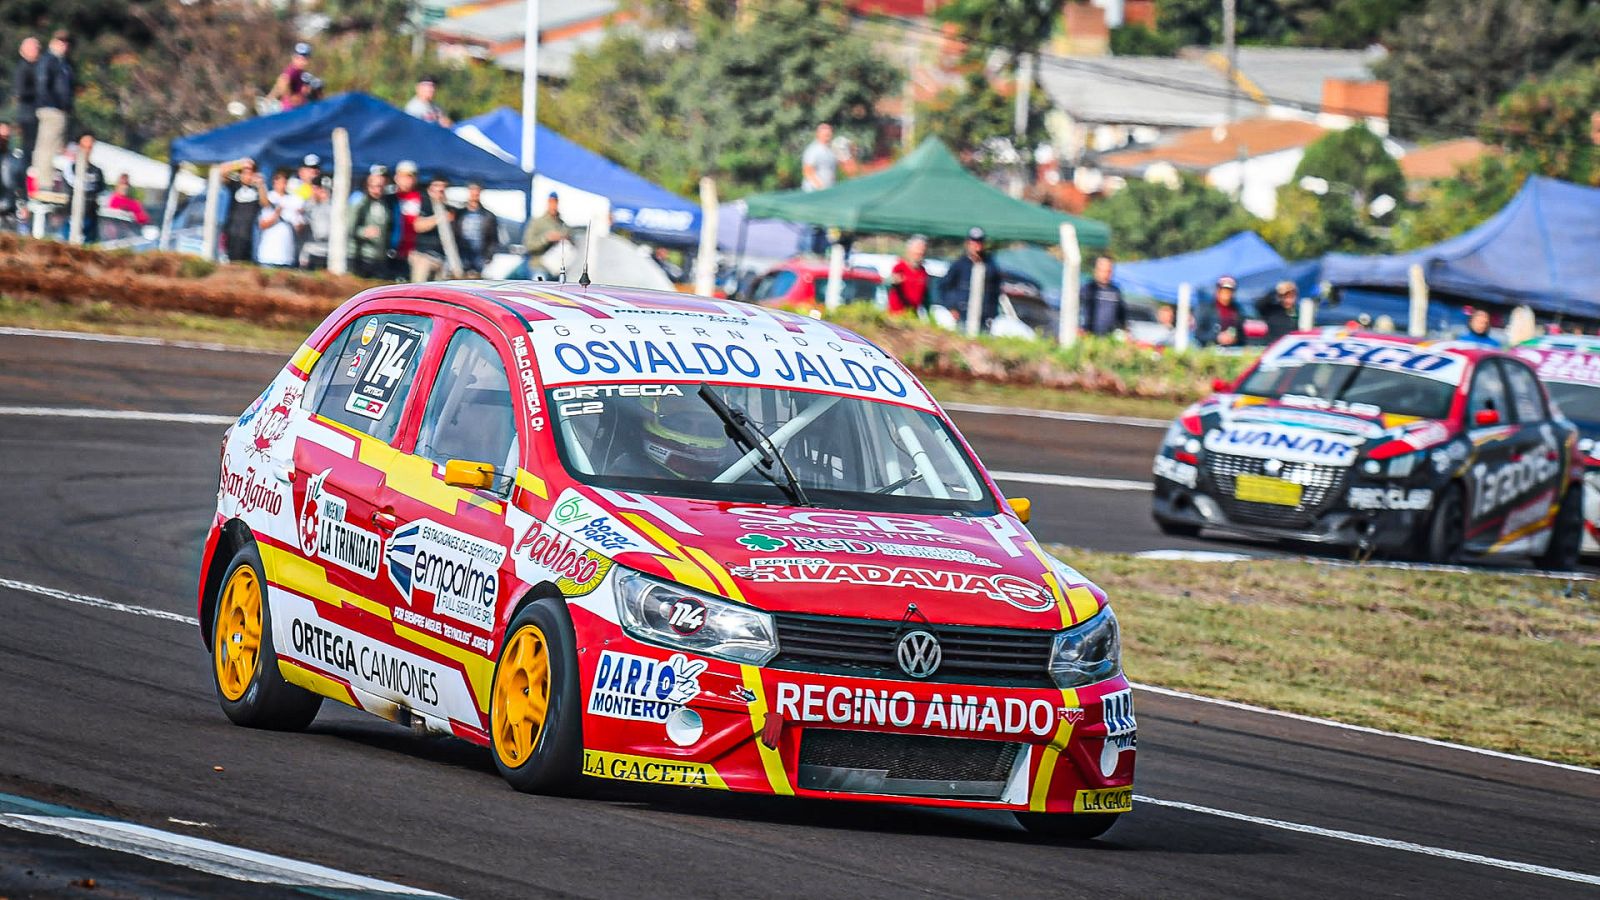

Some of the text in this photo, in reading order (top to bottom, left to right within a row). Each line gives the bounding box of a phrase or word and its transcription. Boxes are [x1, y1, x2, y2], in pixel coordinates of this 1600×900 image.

[512, 335, 531, 369] PABLO
[554, 324, 876, 360] GOBERNADOR
[555, 340, 907, 398] OSVALDO JALDO
[521, 368, 542, 416] ORTEGA
[552, 385, 683, 401] ORTEGA
[560, 401, 604, 417] C2
[727, 506, 945, 535] SGB
[740, 523, 962, 544] CONSULTING
[320, 520, 378, 574] LA TRINIDAD
[422, 526, 460, 549] ESTACIONES
[459, 539, 470, 553] DE
[516, 520, 598, 584] Pabloso
[415, 550, 495, 607] empalme
[755, 564, 999, 594] RIVADAVIA
[442, 595, 493, 625] FULL SERVICE SRL
[292, 618, 438, 706] ORTEGA CAMIONES
[596, 655, 675, 700] DARIO
[777, 682, 1053, 736] REGINO AMADO
[585, 753, 709, 785] LA GACETA
[1082, 792, 1100, 810] LA
